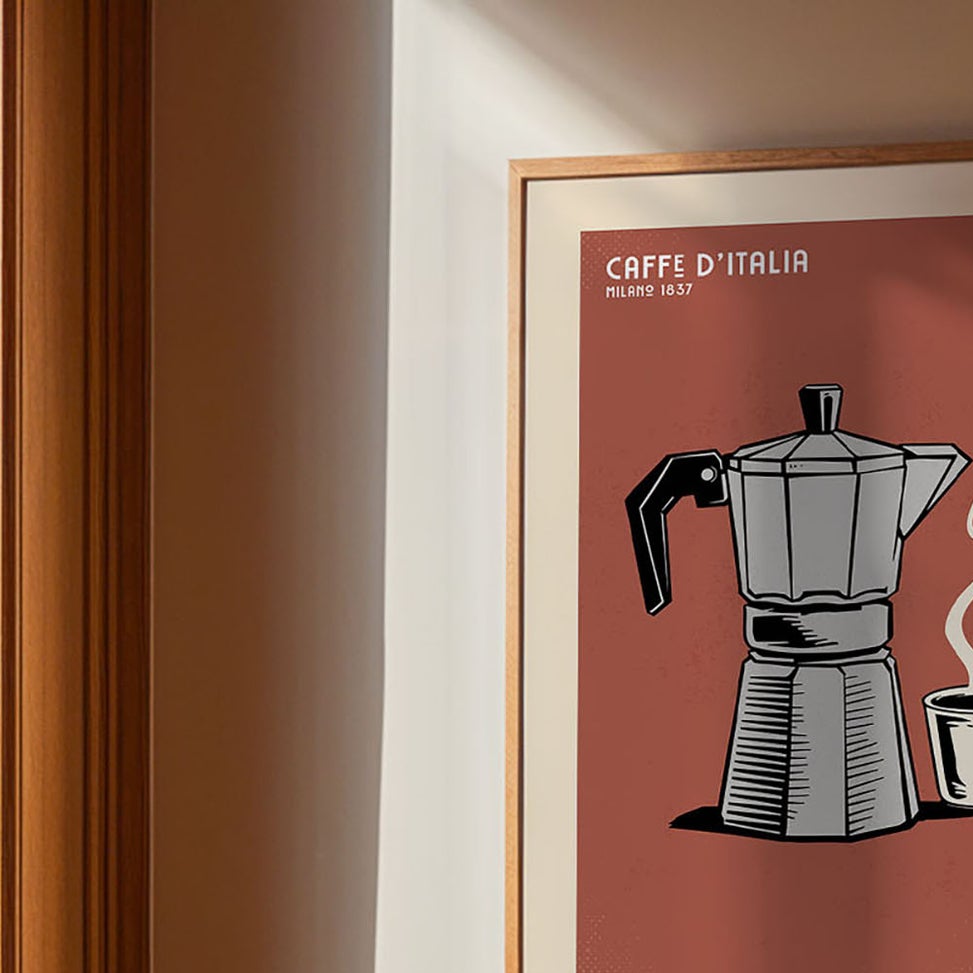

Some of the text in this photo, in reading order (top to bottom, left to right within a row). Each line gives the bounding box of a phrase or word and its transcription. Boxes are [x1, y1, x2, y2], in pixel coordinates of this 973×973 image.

[605, 249, 809, 280] CAFFE D'ITALIA
[605, 283, 693, 298] MILANO 1837
